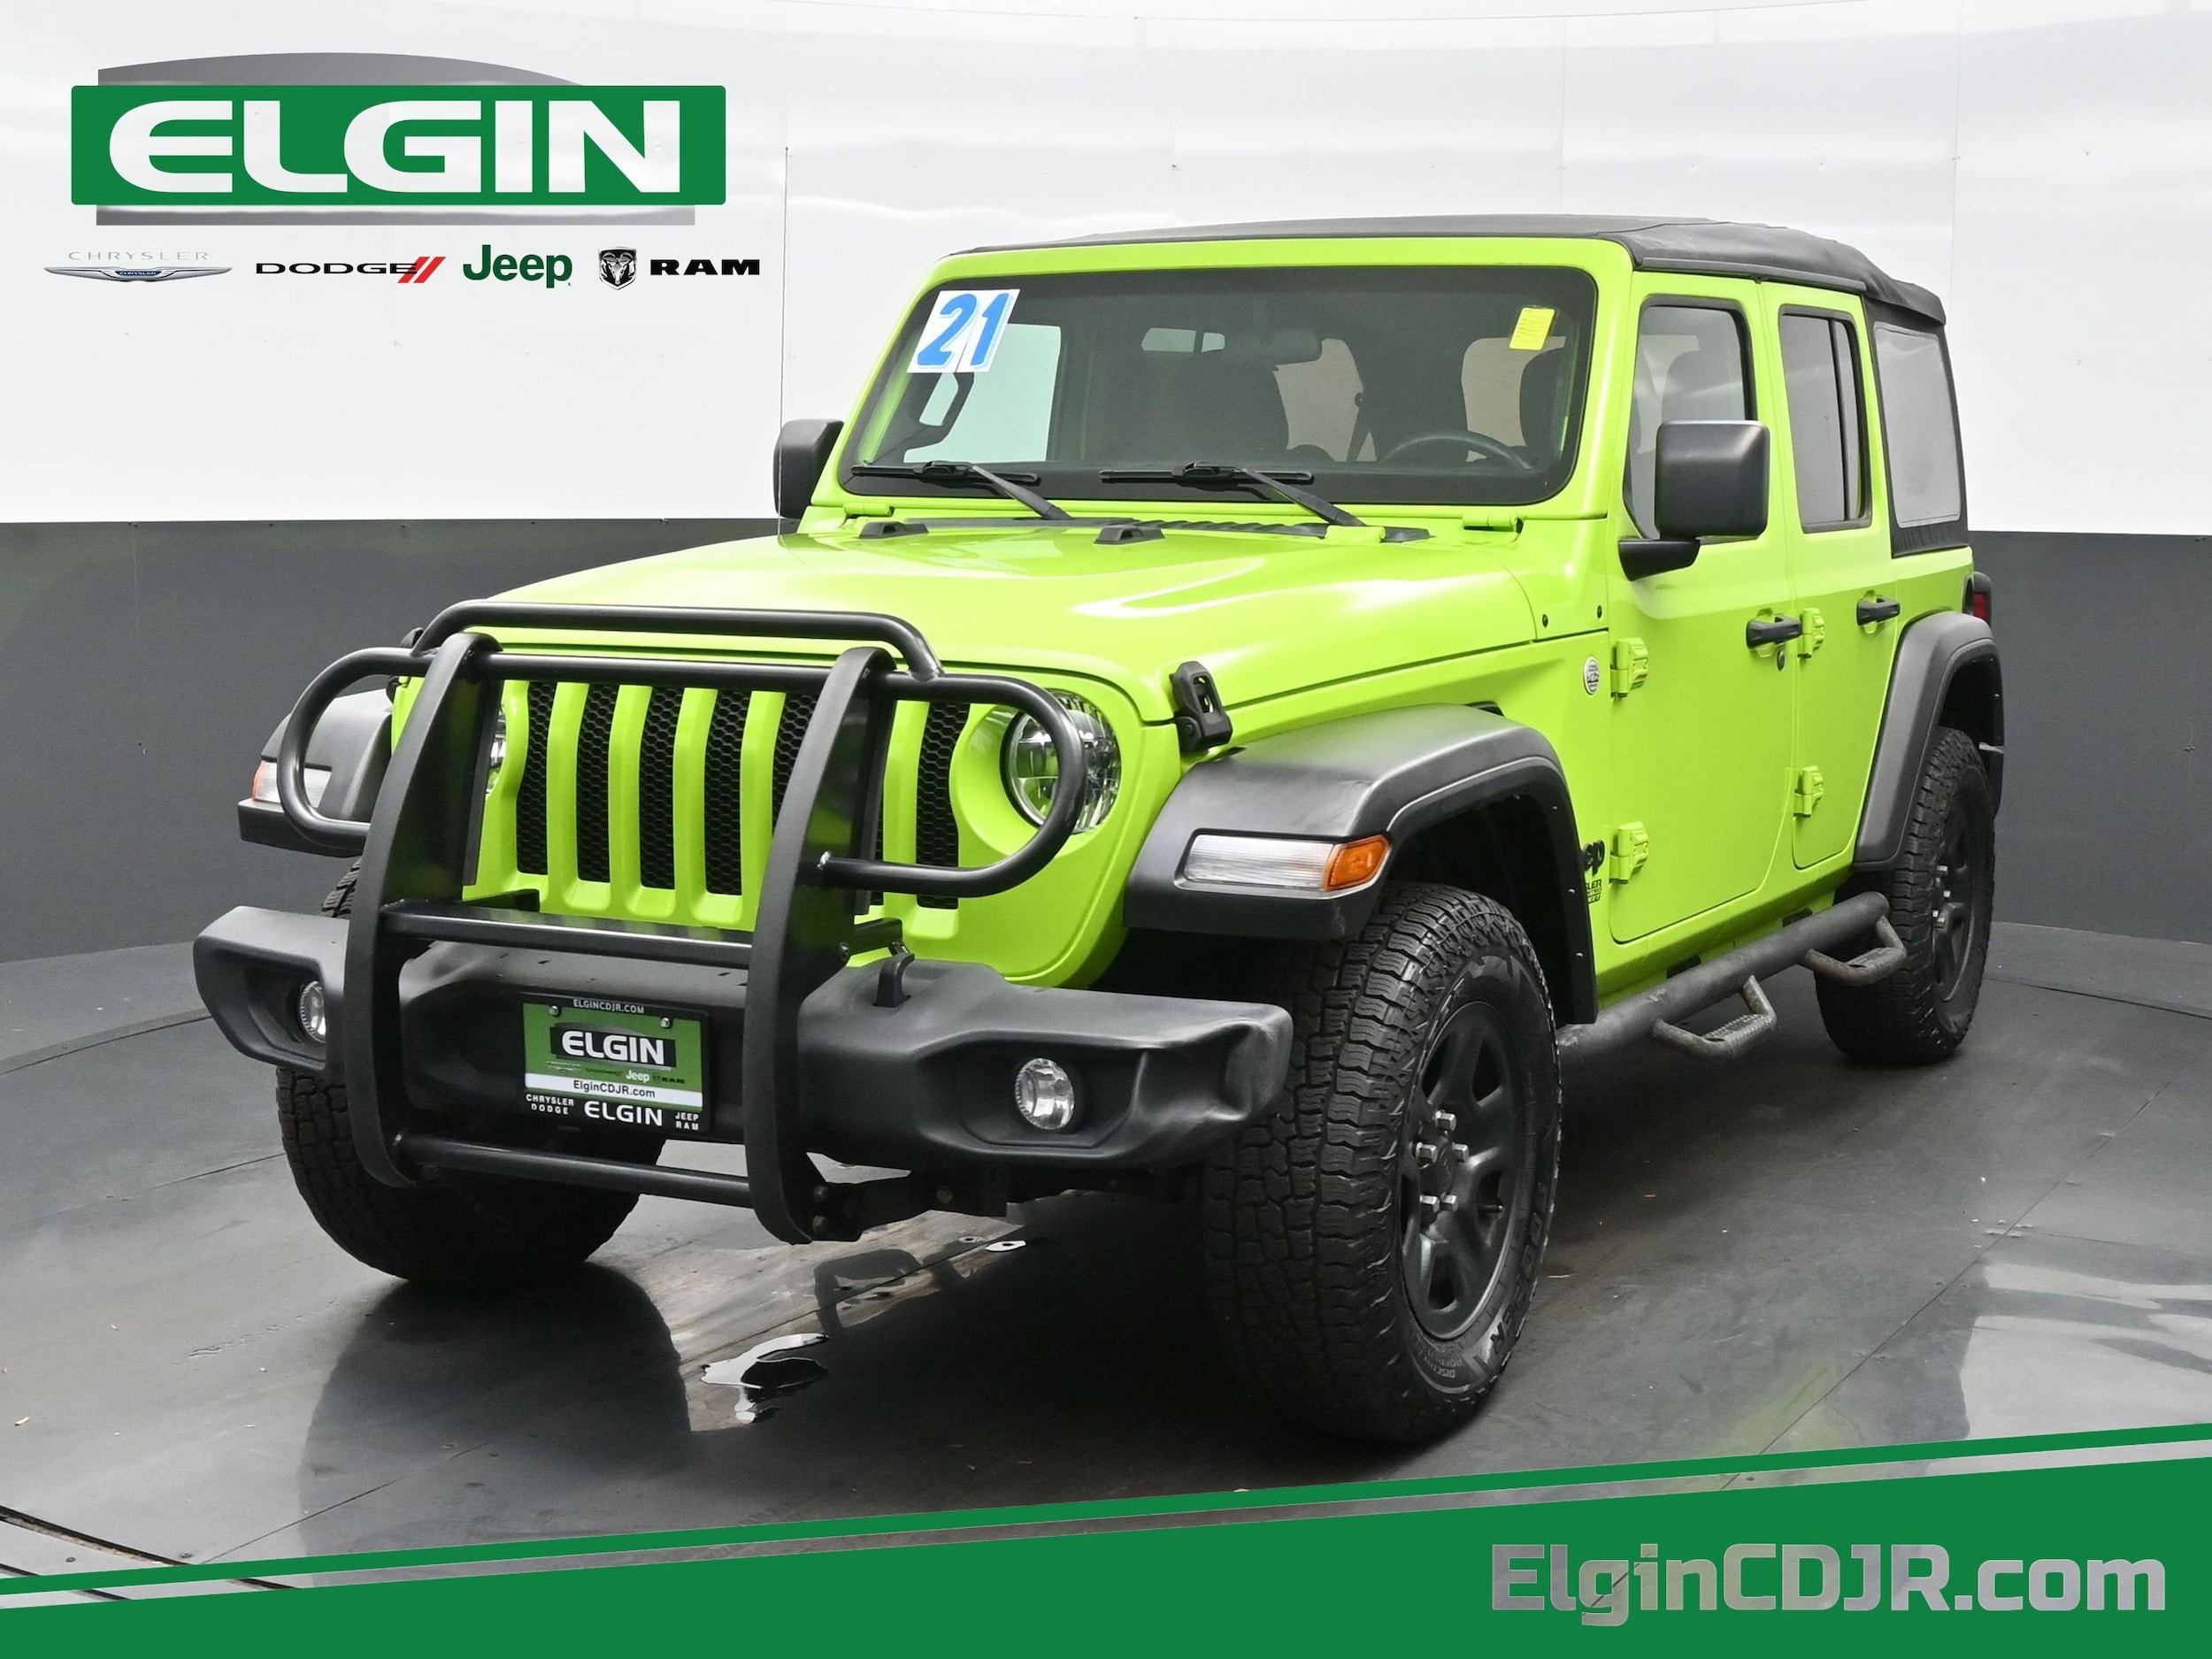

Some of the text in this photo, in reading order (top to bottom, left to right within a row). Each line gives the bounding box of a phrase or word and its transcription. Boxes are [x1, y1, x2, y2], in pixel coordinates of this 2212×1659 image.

[918, 293, 1010, 365] 21
[573, 999, 645, 1014] ELGINCDJR.COM
[562, 1031, 664, 1065] ELGIN
[626, 1070, 650, 1084] Jeep
[573, 1079, 656, 1098] ElginCDJR.com
[526, 1094, 574, 1107] CHRYSLER
[531, 1103, 569, 1115] DODGE
[584, 1101, 663, 1126] ELGIN
[675, 1111, 699, 1121] JEEP
[675, 1122, 699, 1132] RAM
